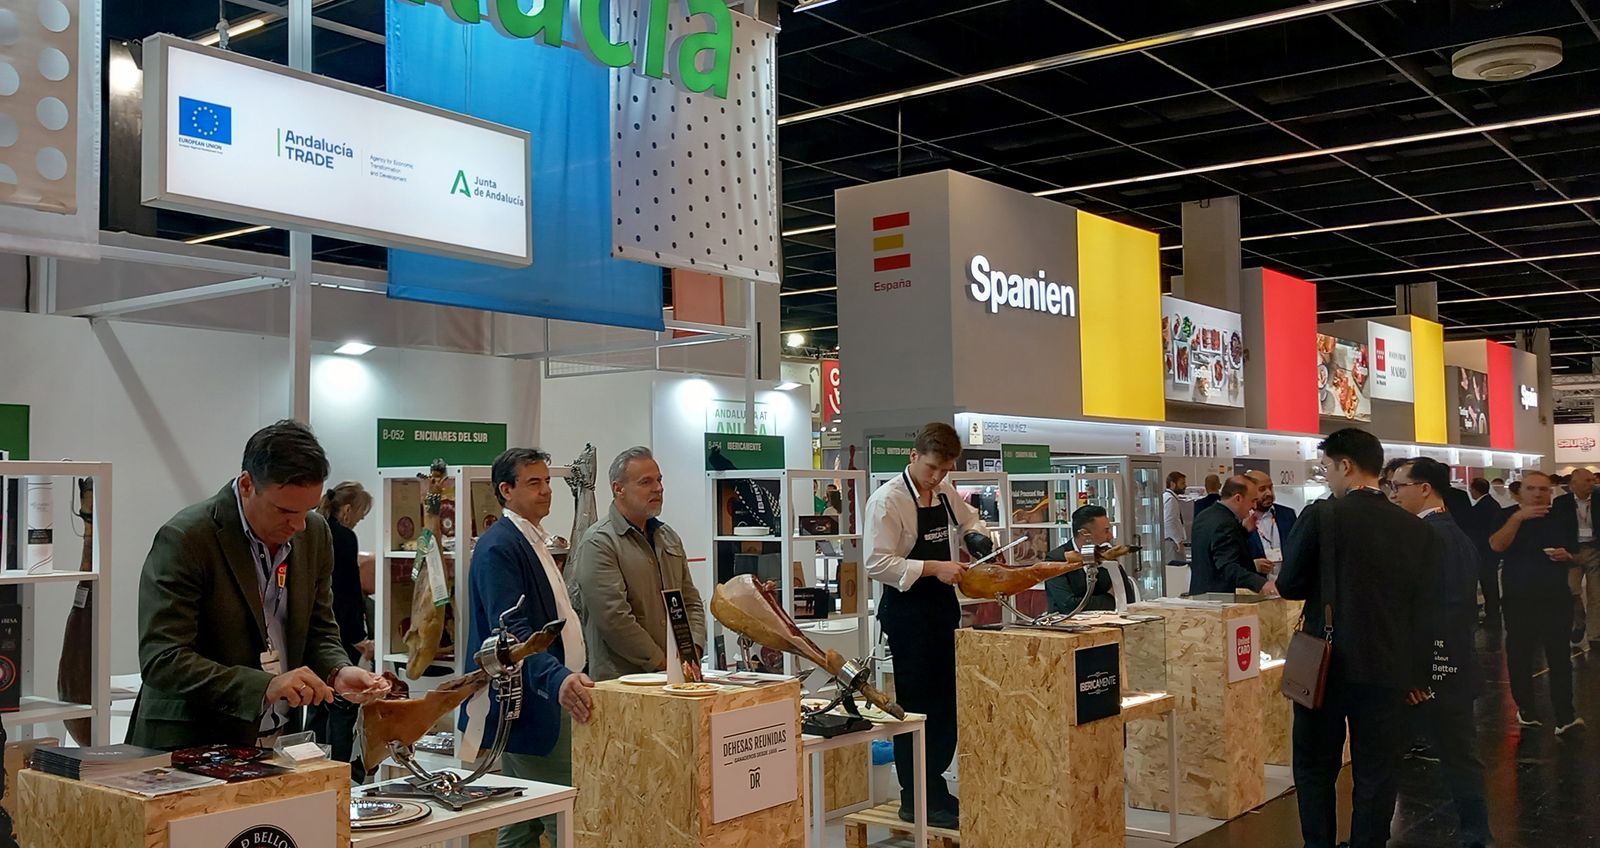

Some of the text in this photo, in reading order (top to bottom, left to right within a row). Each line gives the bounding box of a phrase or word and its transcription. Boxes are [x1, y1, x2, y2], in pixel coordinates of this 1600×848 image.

[178, 137, 205, 147] EUROPEAN
[206, 142, 222, 150] UNION
[285, 130, 353, 158] Andalucía
[285, 146, 334, 169] TRADE
[474, 176, 497, 189] Junta
[474, 187, 524, 207] de Andalucía
[874, 278, 912, 292] España
[970, 254, 1075, 317] Spanien
[715, 408, 768, 420] ANDALUA AT
[382, 429, 488, 443] B-052 ENCINARES DEL SUR
[1432, 664, 1458, 673] Better
[1080, 674, 1117, 692] IBERICAMENTE
[723, 729, 787, 757] DEHESAS REUNIDAS
[749, 771, 761, 789] DR
[254, 831, 292, 848] BELLO
